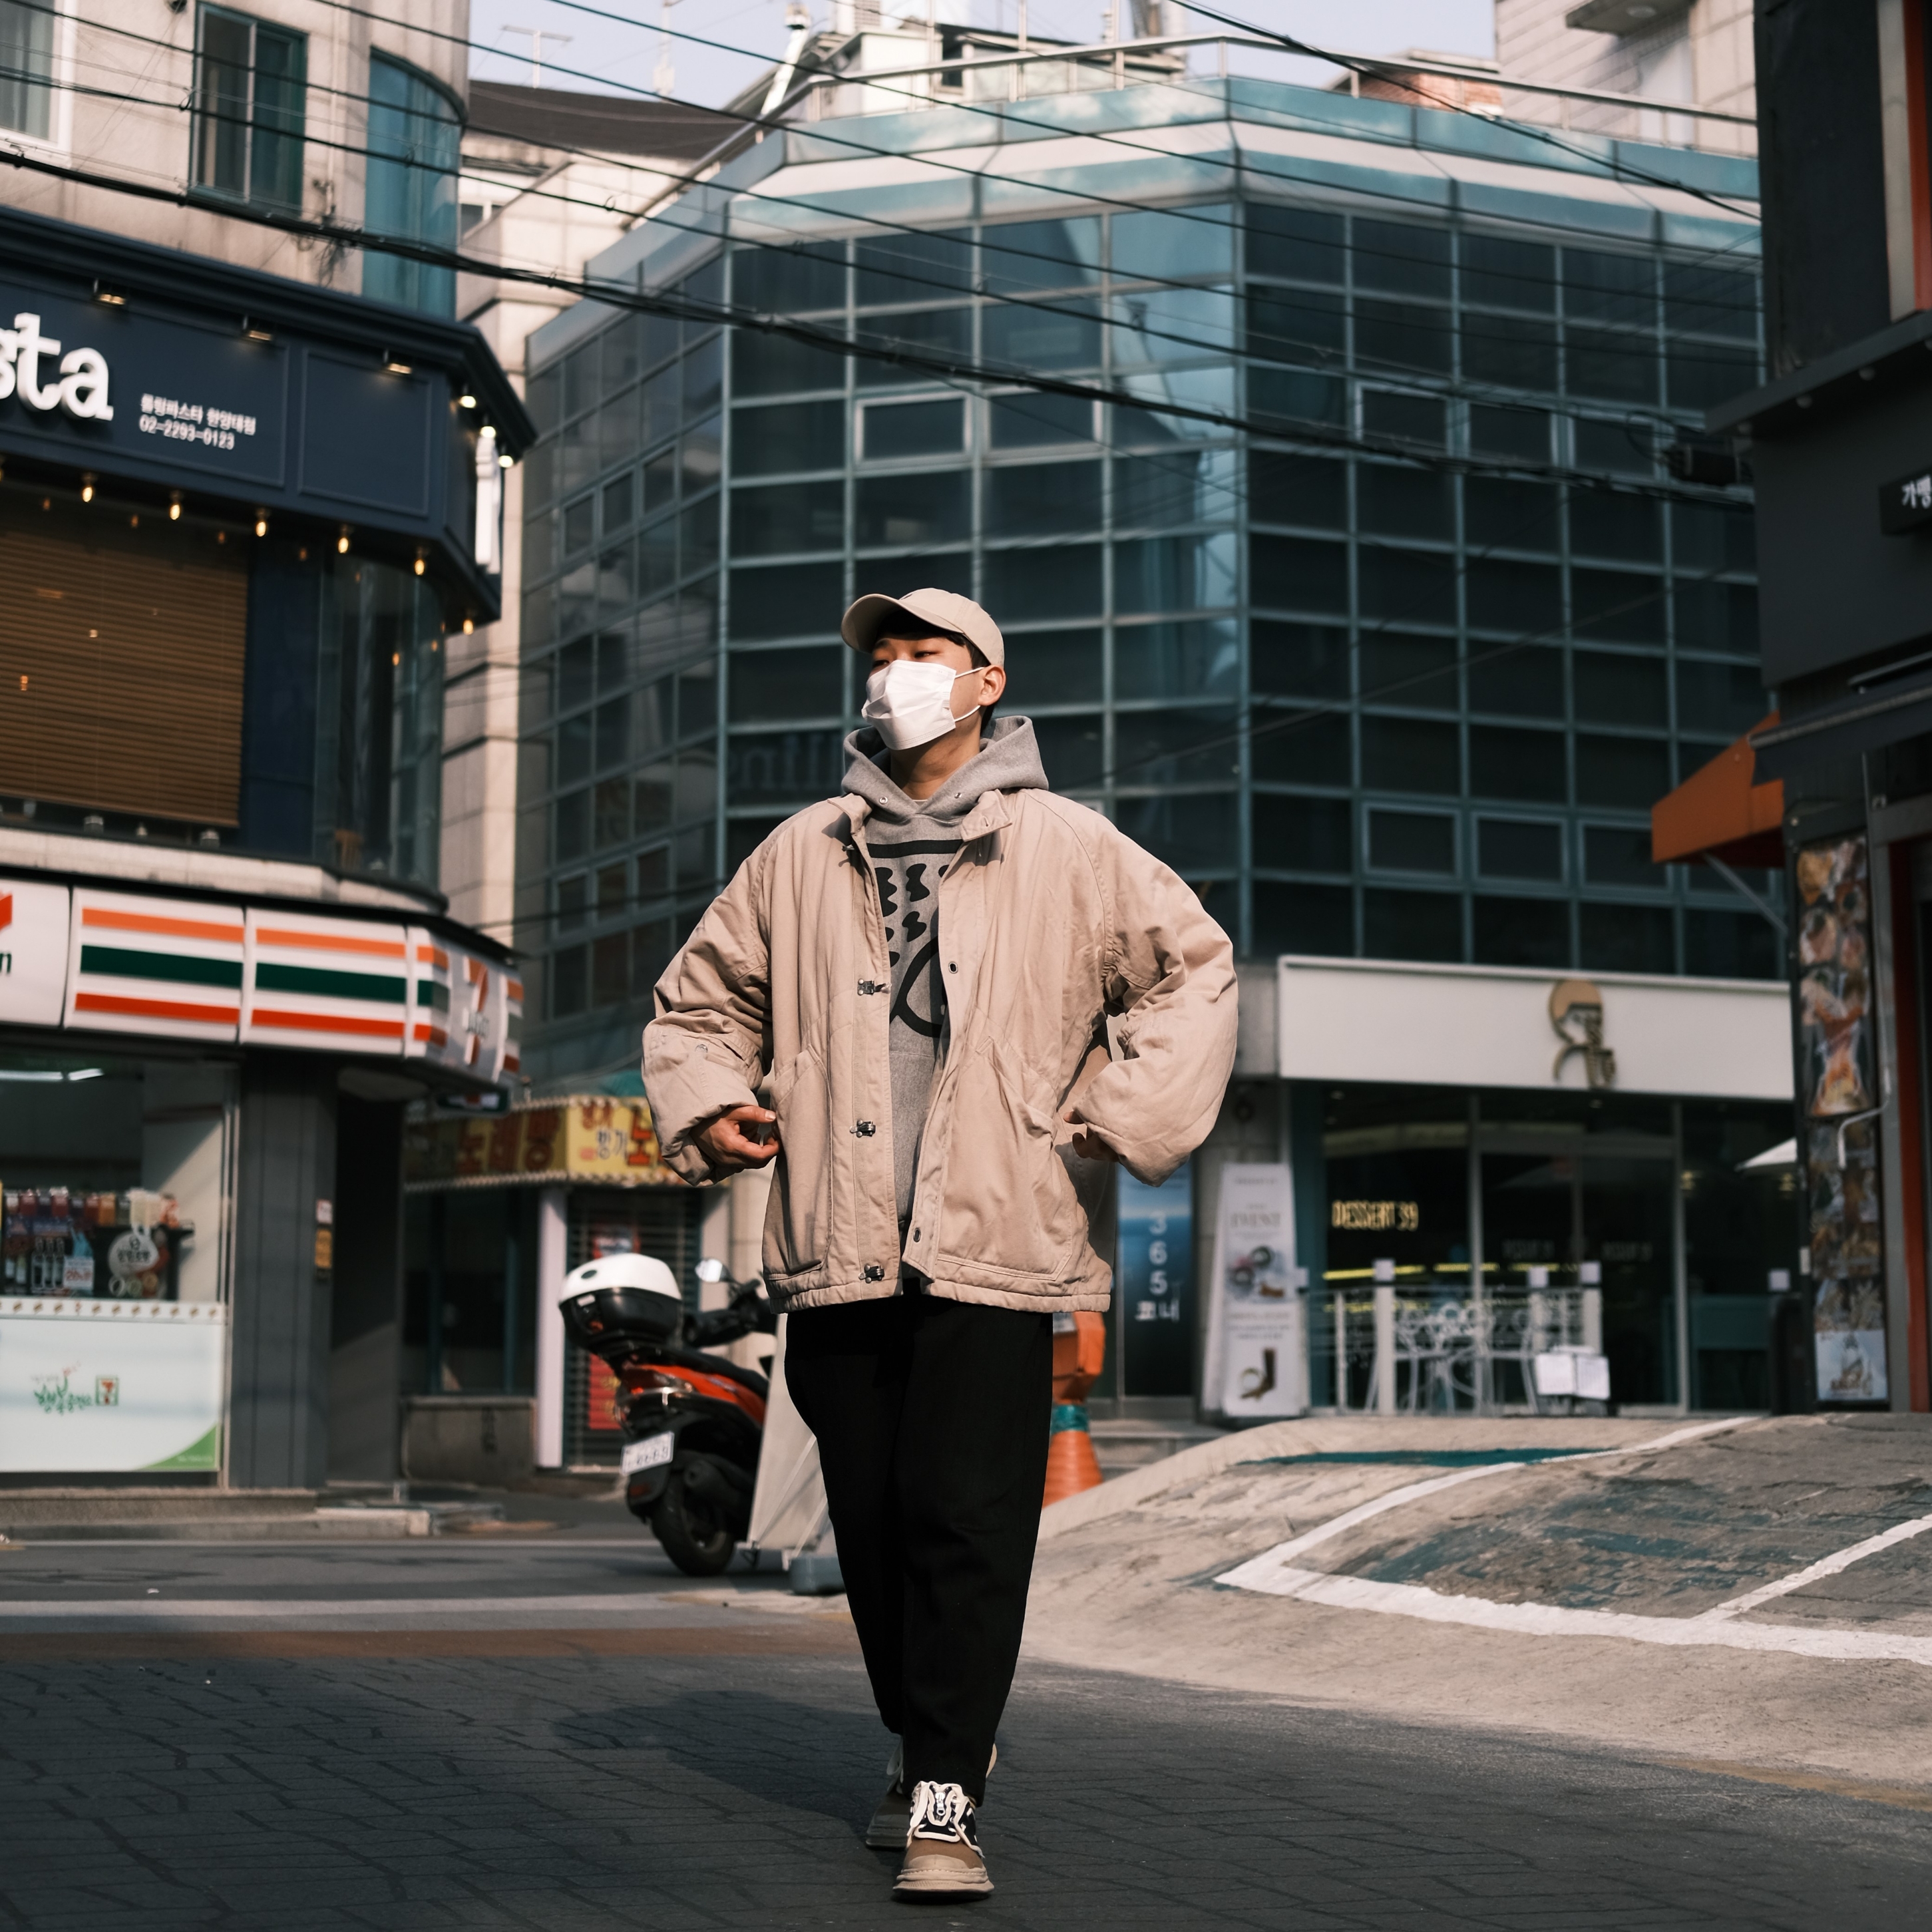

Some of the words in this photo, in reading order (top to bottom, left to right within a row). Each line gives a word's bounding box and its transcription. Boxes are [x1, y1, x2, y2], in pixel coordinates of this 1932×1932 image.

[139, 414, 235, 451] 02-2293-0123
[1332, 1200, 1396, 1229] DESSERT
[1398, 1201, 1419, 1231] 39
